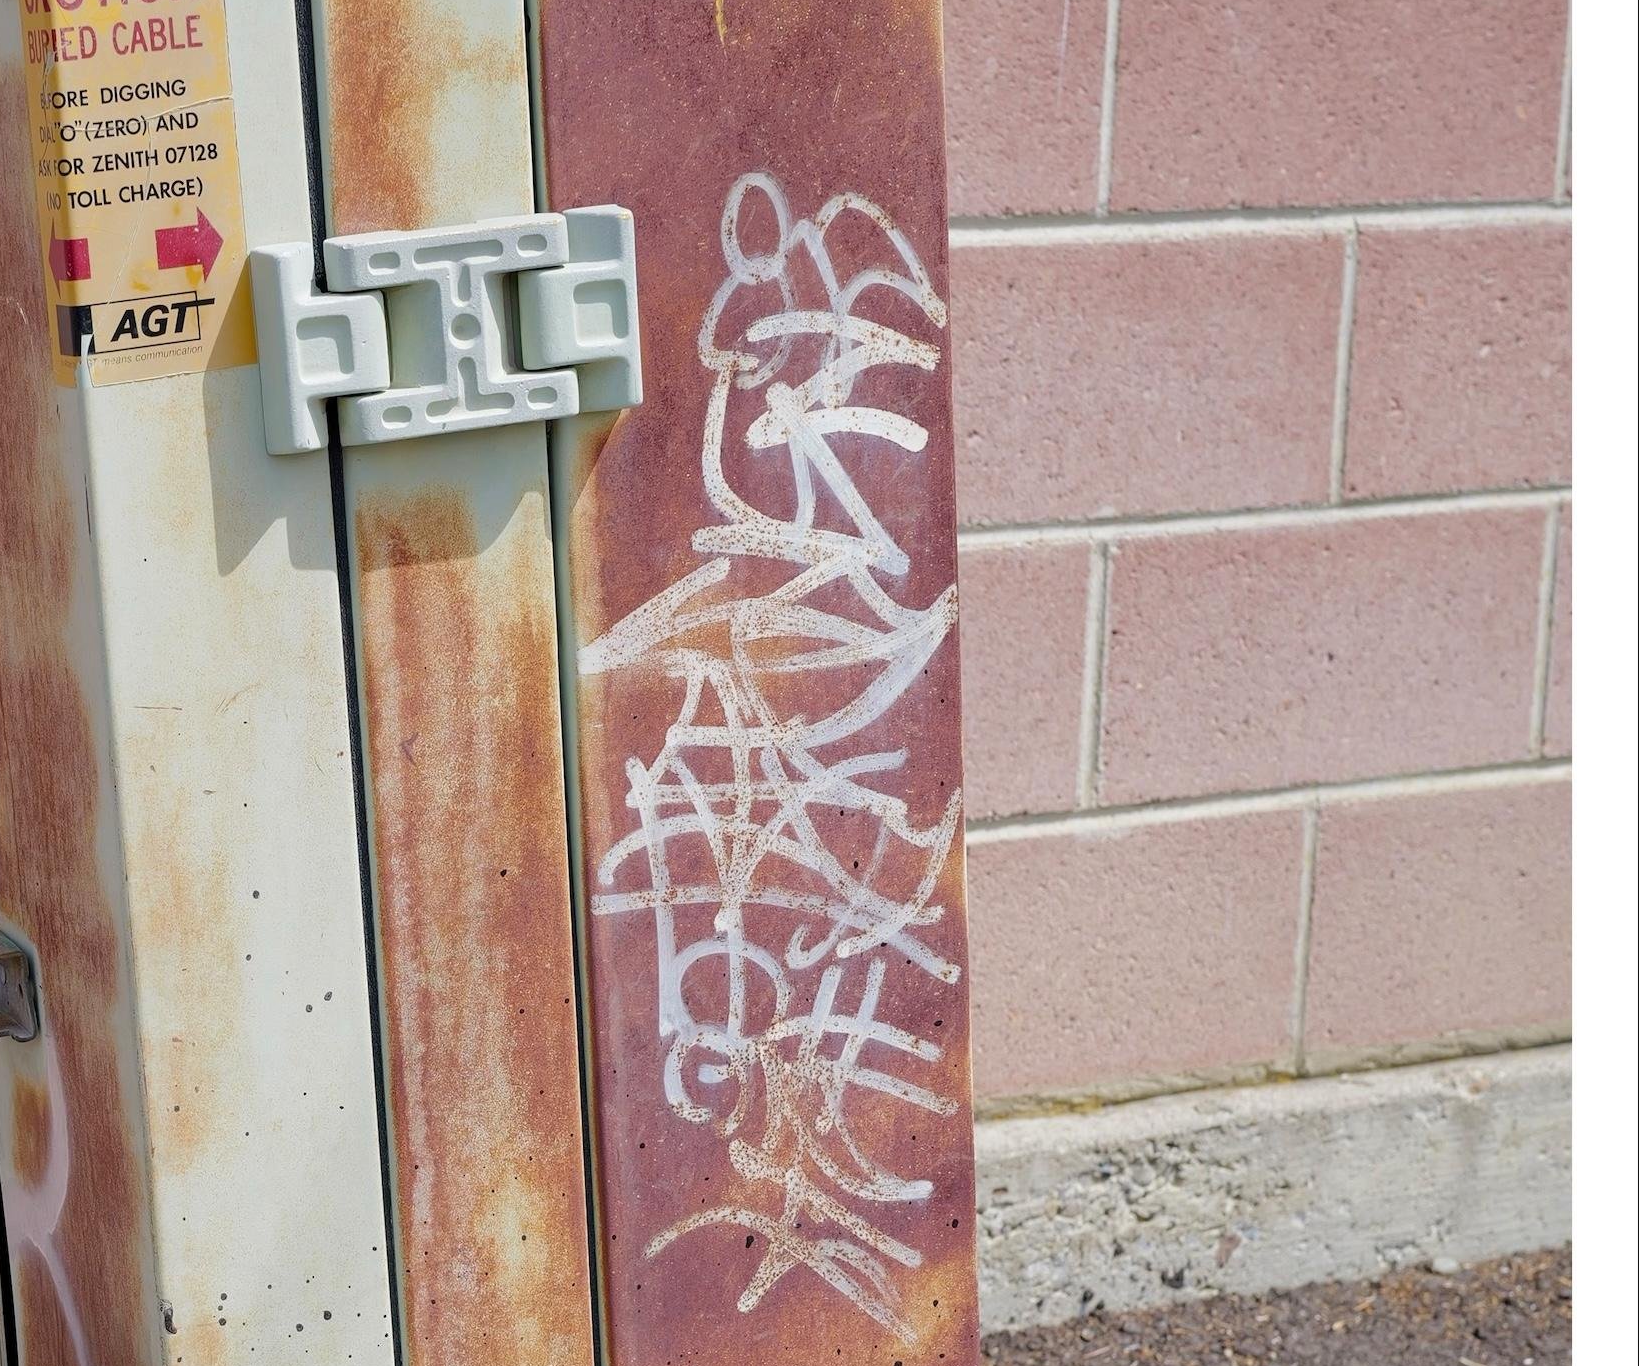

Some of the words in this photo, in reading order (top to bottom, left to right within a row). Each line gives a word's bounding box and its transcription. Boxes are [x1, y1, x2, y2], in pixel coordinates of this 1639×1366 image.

[112, 14, 203, 55] CABLE
[100, 79, 186, 105] DIGGING
[155, 112, 199, 133] AND
[38, 159, 53, 176] ASK
[53, 157, 85, 177] FOR
[92, 148, 159, 174] ZENITH
[165, 143, 218, 165] 07128
[46, 191, 61, 212] (NO
[67, 188, 112, 209] TOLL
[118, 176, 204, 204] CHARGE)
[110, 297, 216, 343] AGT
[135, 344, 203, 362] communication
